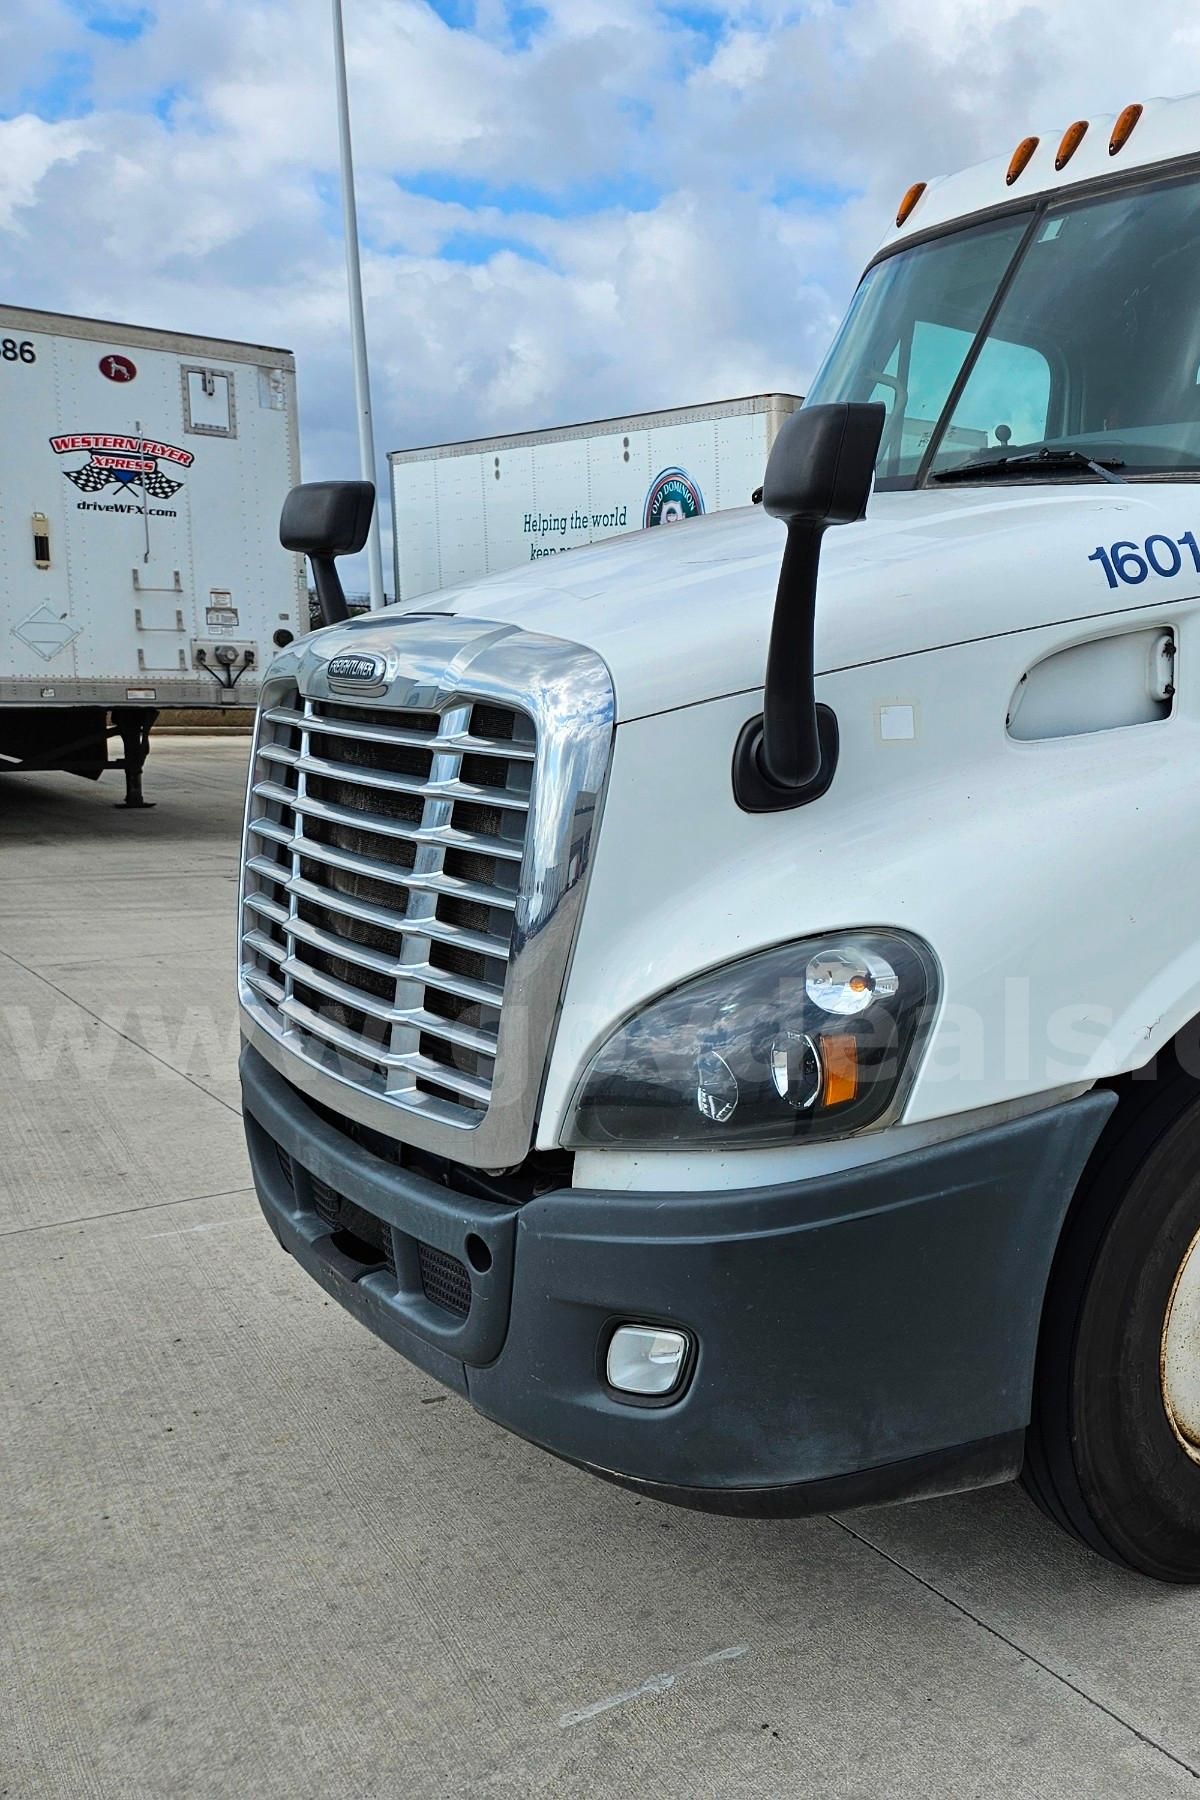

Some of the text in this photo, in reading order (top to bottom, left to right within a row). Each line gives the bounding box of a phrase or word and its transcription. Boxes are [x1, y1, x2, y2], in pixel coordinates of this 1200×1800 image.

[0, 338, 37, 364] 86
[53, 435, 192, 465] WESTERN FLYER
[93, 456, 155, 471] XPRESS
[76, 500, 178, 518] driveWFX.com
[652, 480, 696, 515] OLD DOMINION
[523, 505, 627, 537] Helping the world
[328, 659, 375, 676] FREIGHTLINER
